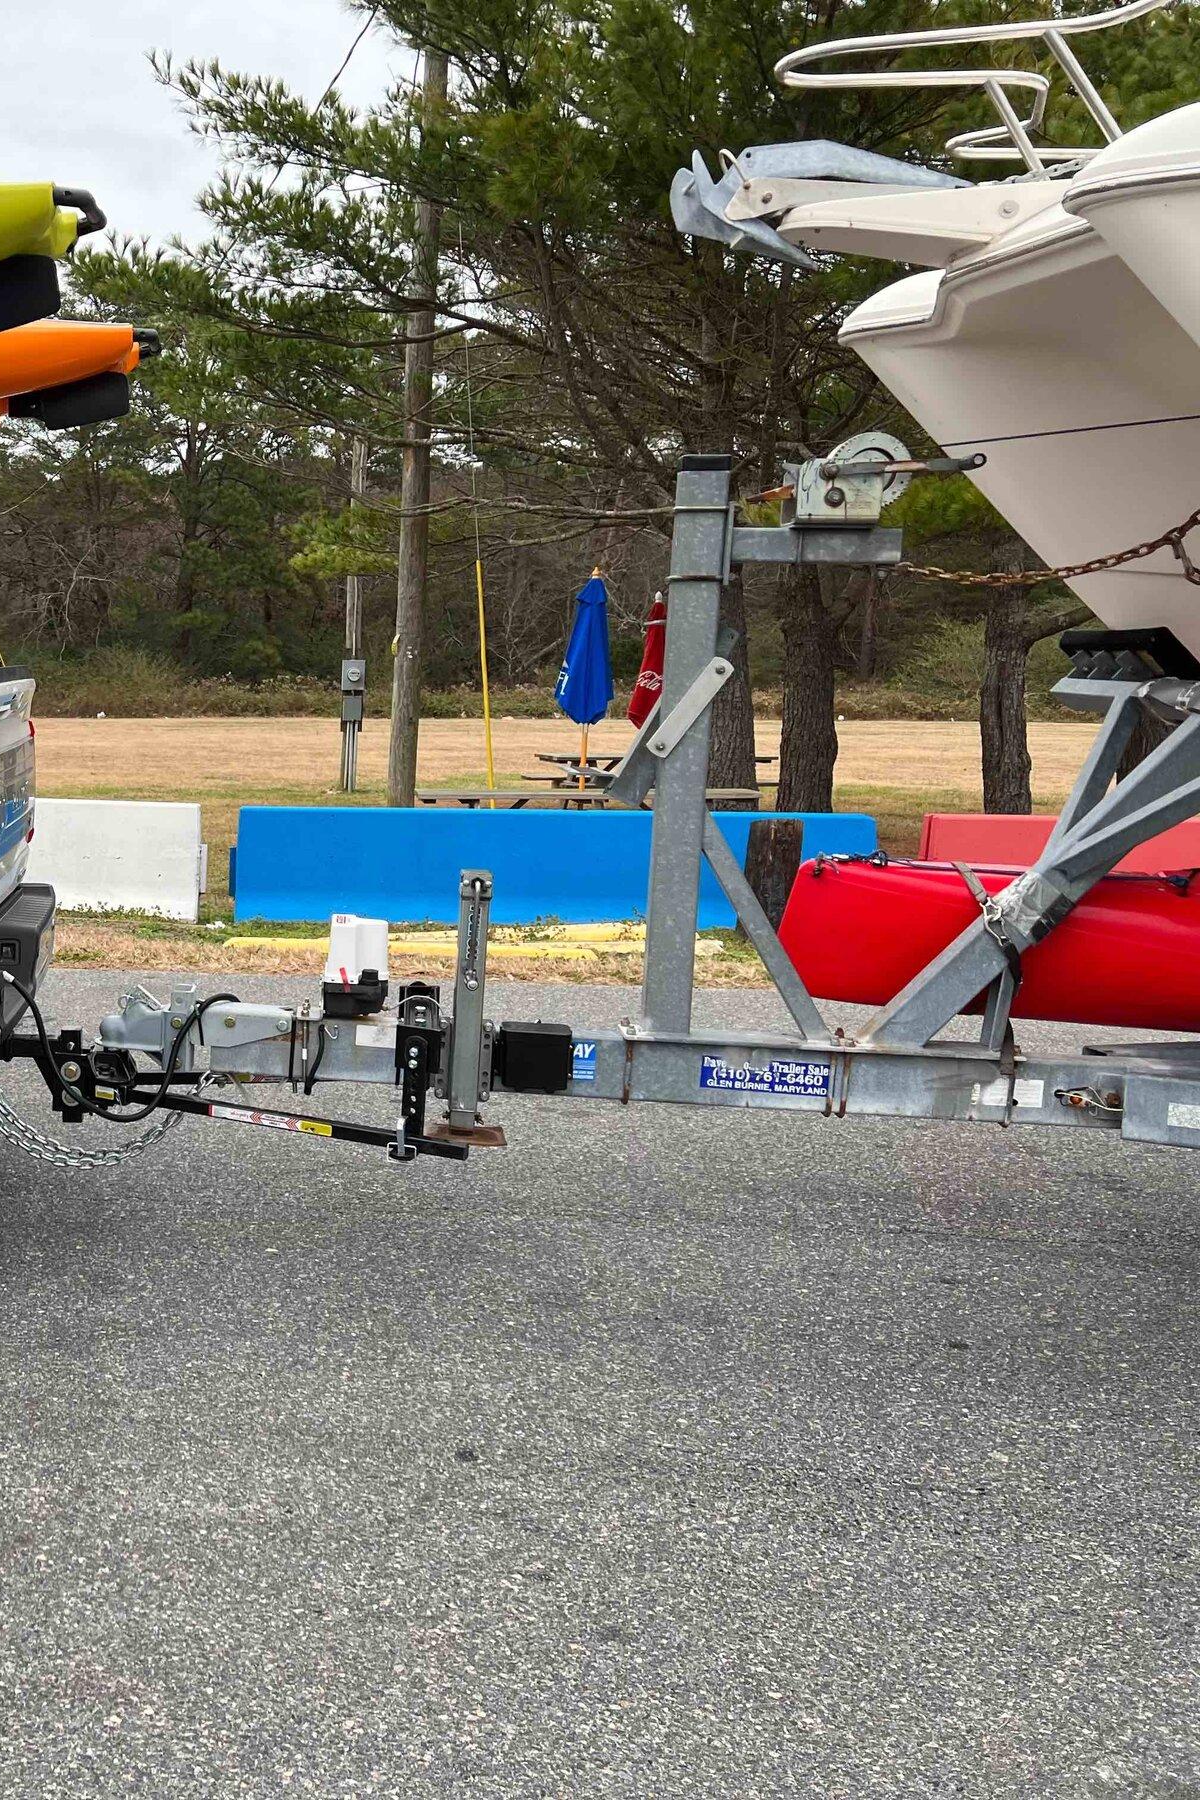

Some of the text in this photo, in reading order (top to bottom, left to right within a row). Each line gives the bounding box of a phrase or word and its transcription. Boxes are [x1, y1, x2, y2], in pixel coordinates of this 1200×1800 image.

[772, 1062, 806, 1074] Trailer
[755, 1071, 823, 1086] 761-6460
[707, 1078, 827, 1095] GLEN BURNIE, MARYLAND
